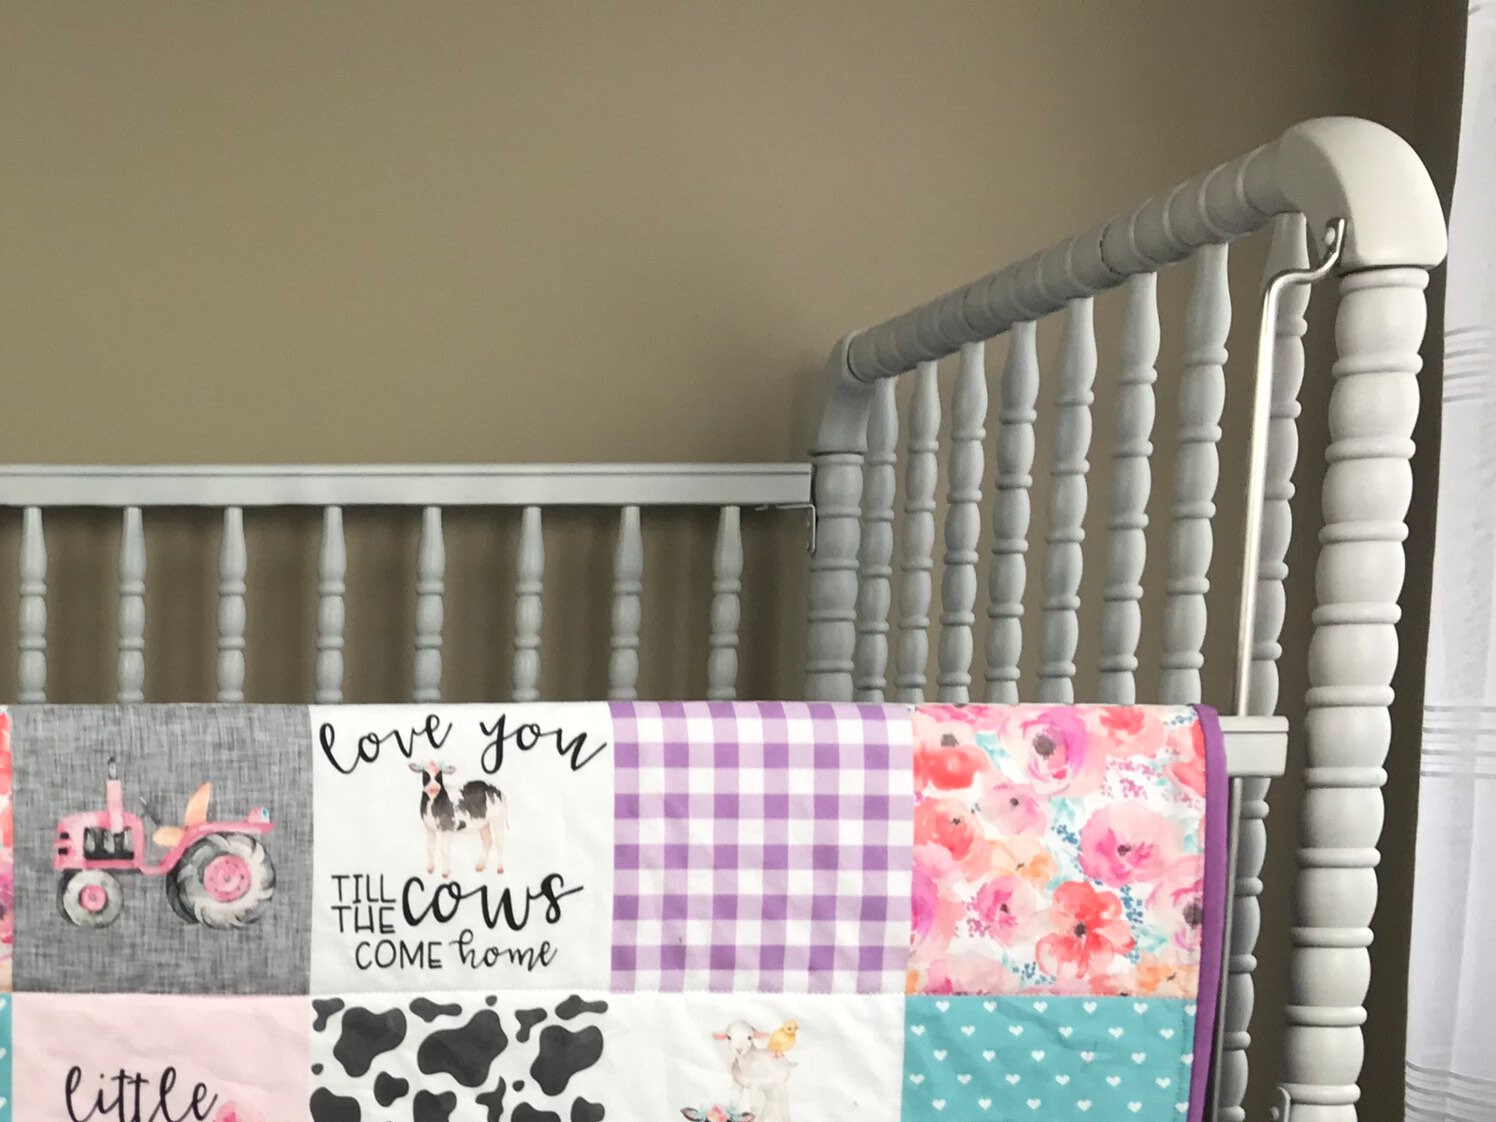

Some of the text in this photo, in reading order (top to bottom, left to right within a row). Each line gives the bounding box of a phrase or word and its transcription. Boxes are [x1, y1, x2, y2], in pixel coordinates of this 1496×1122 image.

[319, 713, 607, 774] love you
[331, 874, 396, 904] TILL
[331, 905, 396, 933] THE
[355, 929, 557, 971] COME home
